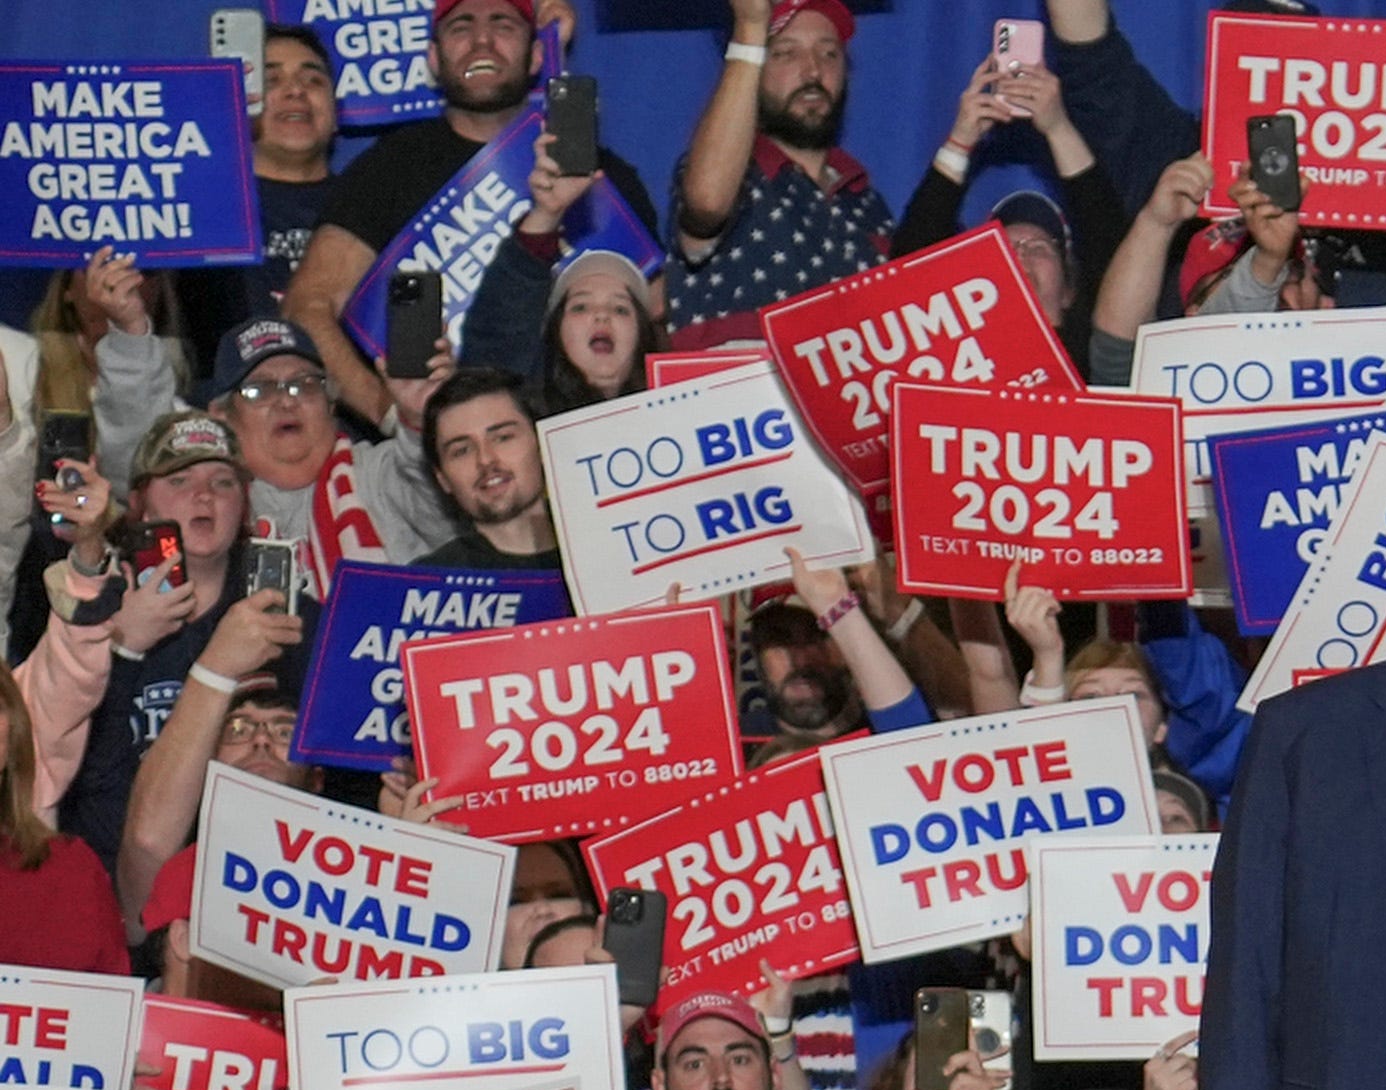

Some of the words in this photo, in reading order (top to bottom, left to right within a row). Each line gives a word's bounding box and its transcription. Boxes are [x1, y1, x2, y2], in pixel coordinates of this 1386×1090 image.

[335, 16, 429, 58] GRE
[31, 82, 163, 118] MAKE
[335, 56, 436, 98] AGA
[0, 122, 211, 158] AMERICA
[28, 163, 183, 200] GREAT
[1299, 166, 1367, 186] RUMP
[31, 203, 191, 240] AGAIN!
[397, 171, 516, 272] MAKE
[794, 278, 998, 388] TRUMP
[1162, 360, 1273, 403] TOO
[576, 436, 683, 496] TOO
[696, 408, 794, 468] BIG
[918, 423, 1153, 488] TRUMP
[612, 514, 685, 562] TO
[696, 486, 793, 541] RIG
[951, 481, 1119, 539] 2024
[919, 535, 972, 556] TEXT
[976, 540, 1044, 564] TRUMP
[1052, 548, 1082, 565] TO
[1091, 549, 1163, 564] 88022
[400, 588, 521, 627] MAKE
[1317, 601, 1377, 669] OO
[440, 650, 696, 730] TRUMP
[486, 707, 670, 780] 2024
[906, 740, 1073, 803] VOTE
[458, 786, 509, 811] EXT
[518, 775, 599, 802] TRUMP
[606, 769, 637, 788] TO
[644, 757, 717, 783] 88022
[869, 786, 1126, 867] DONALD
[275, 818, 434, 899] VOTE
[901, 848, 1028, 909] TRU
[222, 851, 472, 954] DONALD
[672, 845, 843, 951] 2024
[1112, 870, 1211, 914] VO
[667, 957, 702, 986] EXT
[707, 924, 779, 965] TRUMP
[784, 911, 816, 935] TO
[1065, 924, 1207, 967] DON
[1087, 976, 1206, 1018] TRU
[0, 1004, 69, 1050] TE
[327, 1026, 450, 1074] TOO
[467, 1017, 571, 1066] BIG
